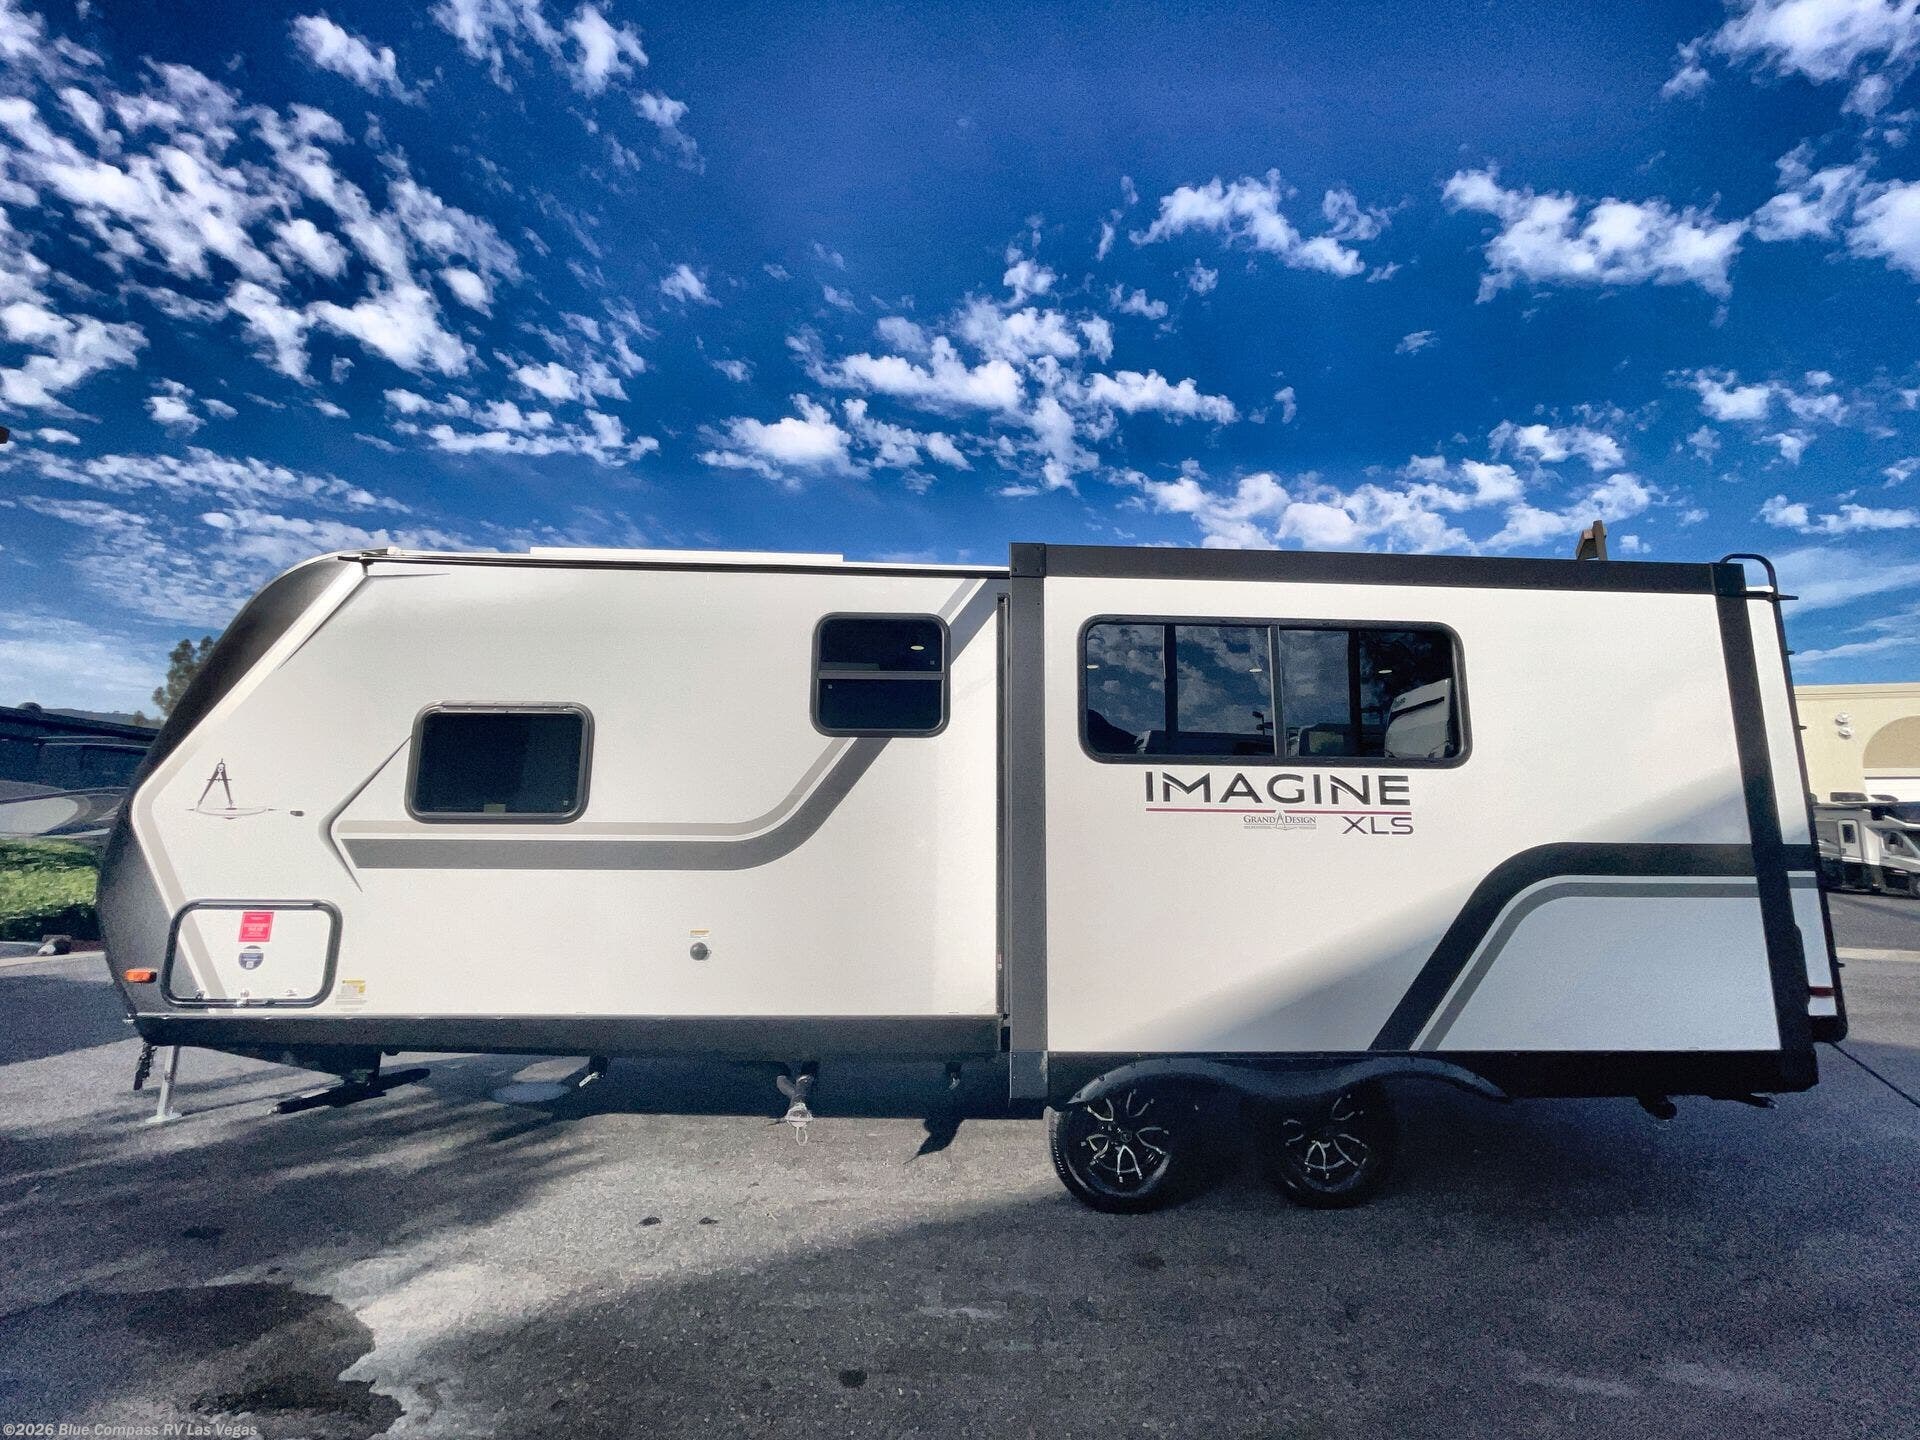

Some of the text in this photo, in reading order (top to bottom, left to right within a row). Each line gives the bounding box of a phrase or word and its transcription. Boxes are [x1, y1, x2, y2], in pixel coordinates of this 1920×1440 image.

[1145, 771, 1410, 806] IMAGINE
[1243, 815, 1317, 824] GRAND DESIGN
[1342, 816, 1414, 835] XLS
